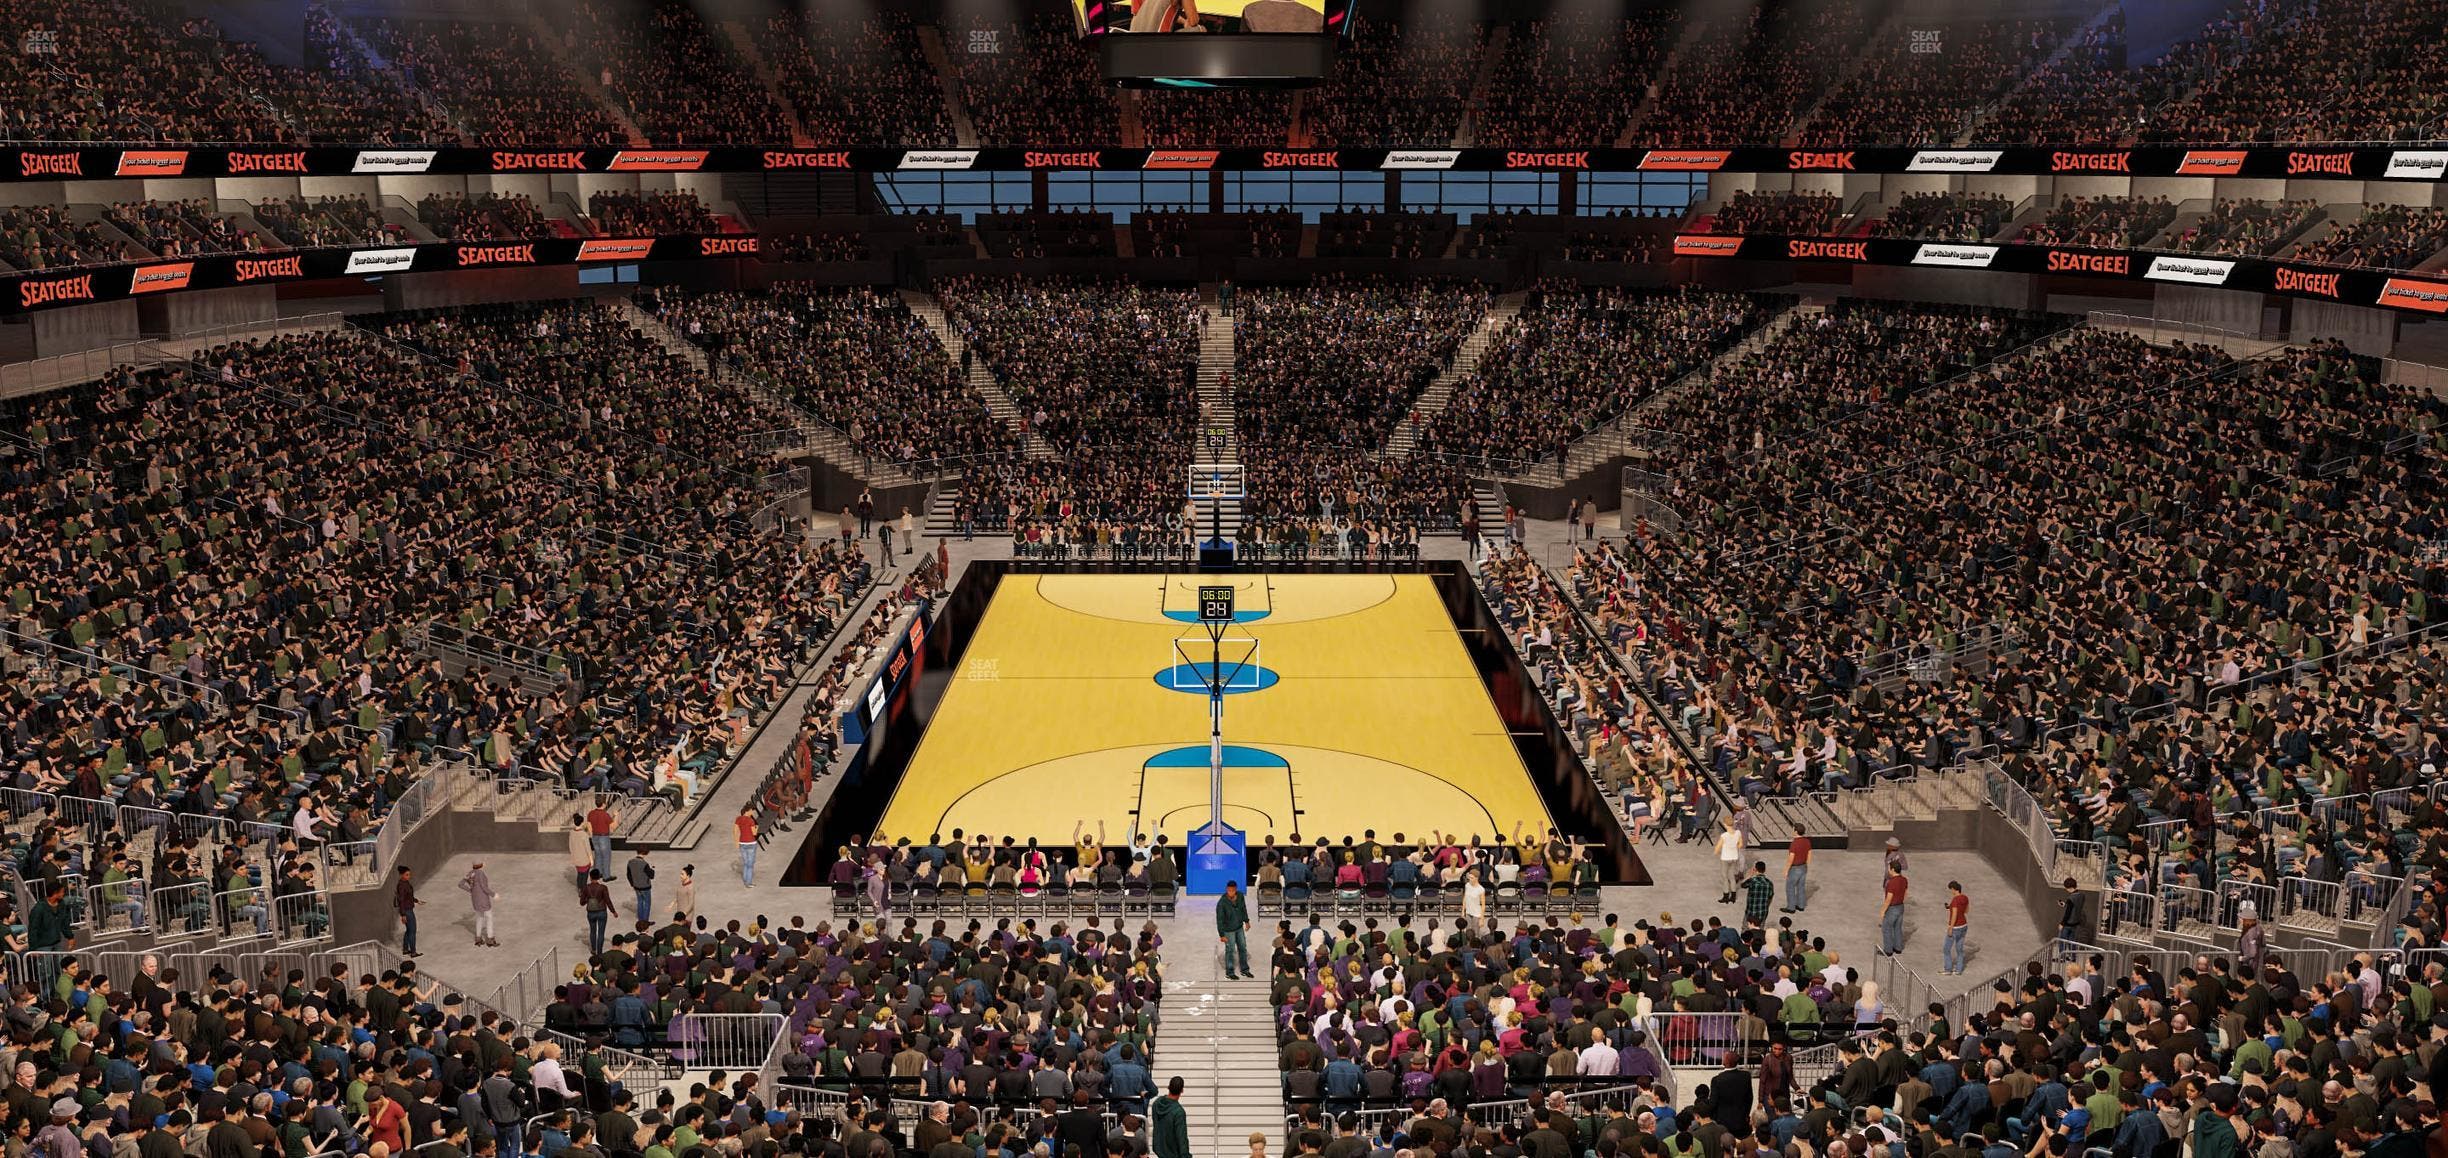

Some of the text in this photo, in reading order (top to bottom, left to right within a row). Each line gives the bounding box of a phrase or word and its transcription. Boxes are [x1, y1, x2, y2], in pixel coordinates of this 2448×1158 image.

[21, 152, 82, 176] SEATGEEK
[228, 152, 308, 172] SEATGEEK
[492, 152, 586, 170] SEATGEEK
[763, 152, 851, 168] SEATGEEK
[1024, 152, 1101, 168] SEATGEEK
[1263, 152, 1339, 168] SEATGEEK
[1506, 152, 1589, 168] SEATGEEK
[2052, 152, 2131, 172] SEATGEEK
[2287, 152, 2353, 175] SEATGEEK
[458, 244, 535, 265] SEATGEEK
[701, 238, 759, 255] SEATGE
[1788, 240, 1868, 261] SEATGEEK
[235, 255, 303, 281] SEATGEEK
[21, 274, 94, 307] SEATGEEK
[2275, 267, 2340, 298] SEATGEEK
[1209, 436, 1223, 446] 24
[1202, 590, 1231, 600] 06:00
[1206, 602, 1226, 616] 24
